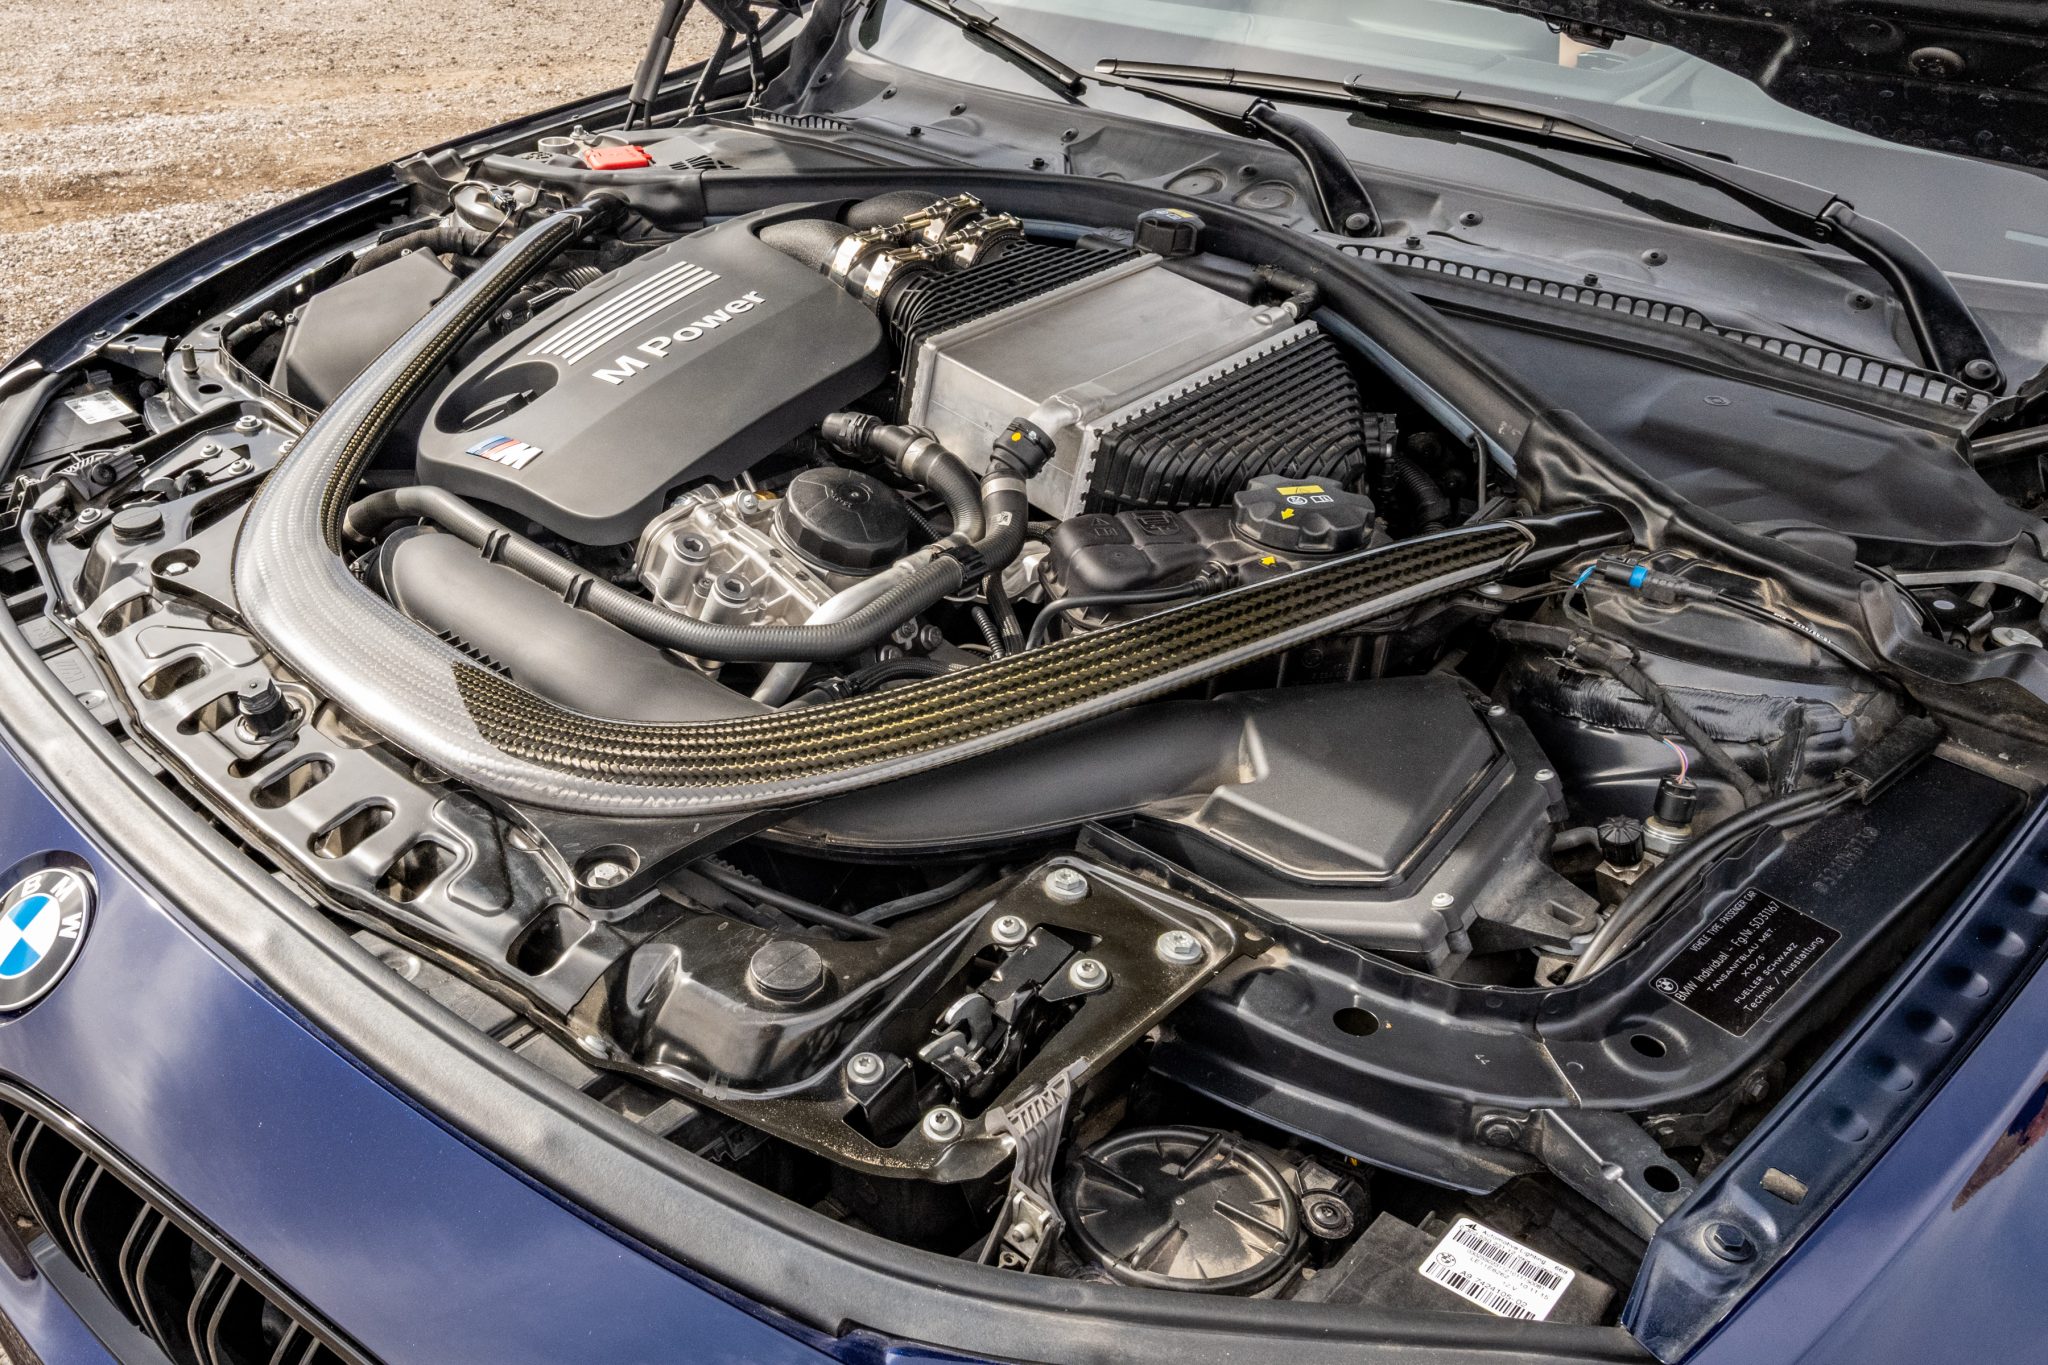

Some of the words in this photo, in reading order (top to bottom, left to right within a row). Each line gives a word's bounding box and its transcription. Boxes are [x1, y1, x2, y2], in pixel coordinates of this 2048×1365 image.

[592, 355, 650, 385] M
[637, 290, 766, 358] Power
[21, 875, 83, 939] BMW
[1720, 899, 1748, 925] PASSENGER
[1743, 890, 1758, 902] CAR
[1674, 980, 1698, 1001] BMW
[1693, 951, 1730, 983] Individual
[1706, 943, 1759, 992] TANSANITBLAU
[1758, 928, 1777, 943] MET.
[1734, 976, 1764, 1004] FUELLER
[1762, 942, 1798, 976] SCHWARZ
[1743, 985, 1775, 1012] Technik
[1780, 936, 1824, 977] Ausstattung
[1482, 1230, 1519, 1250] Automotive
[1519, 1247, 1546, 1265] Lighting
